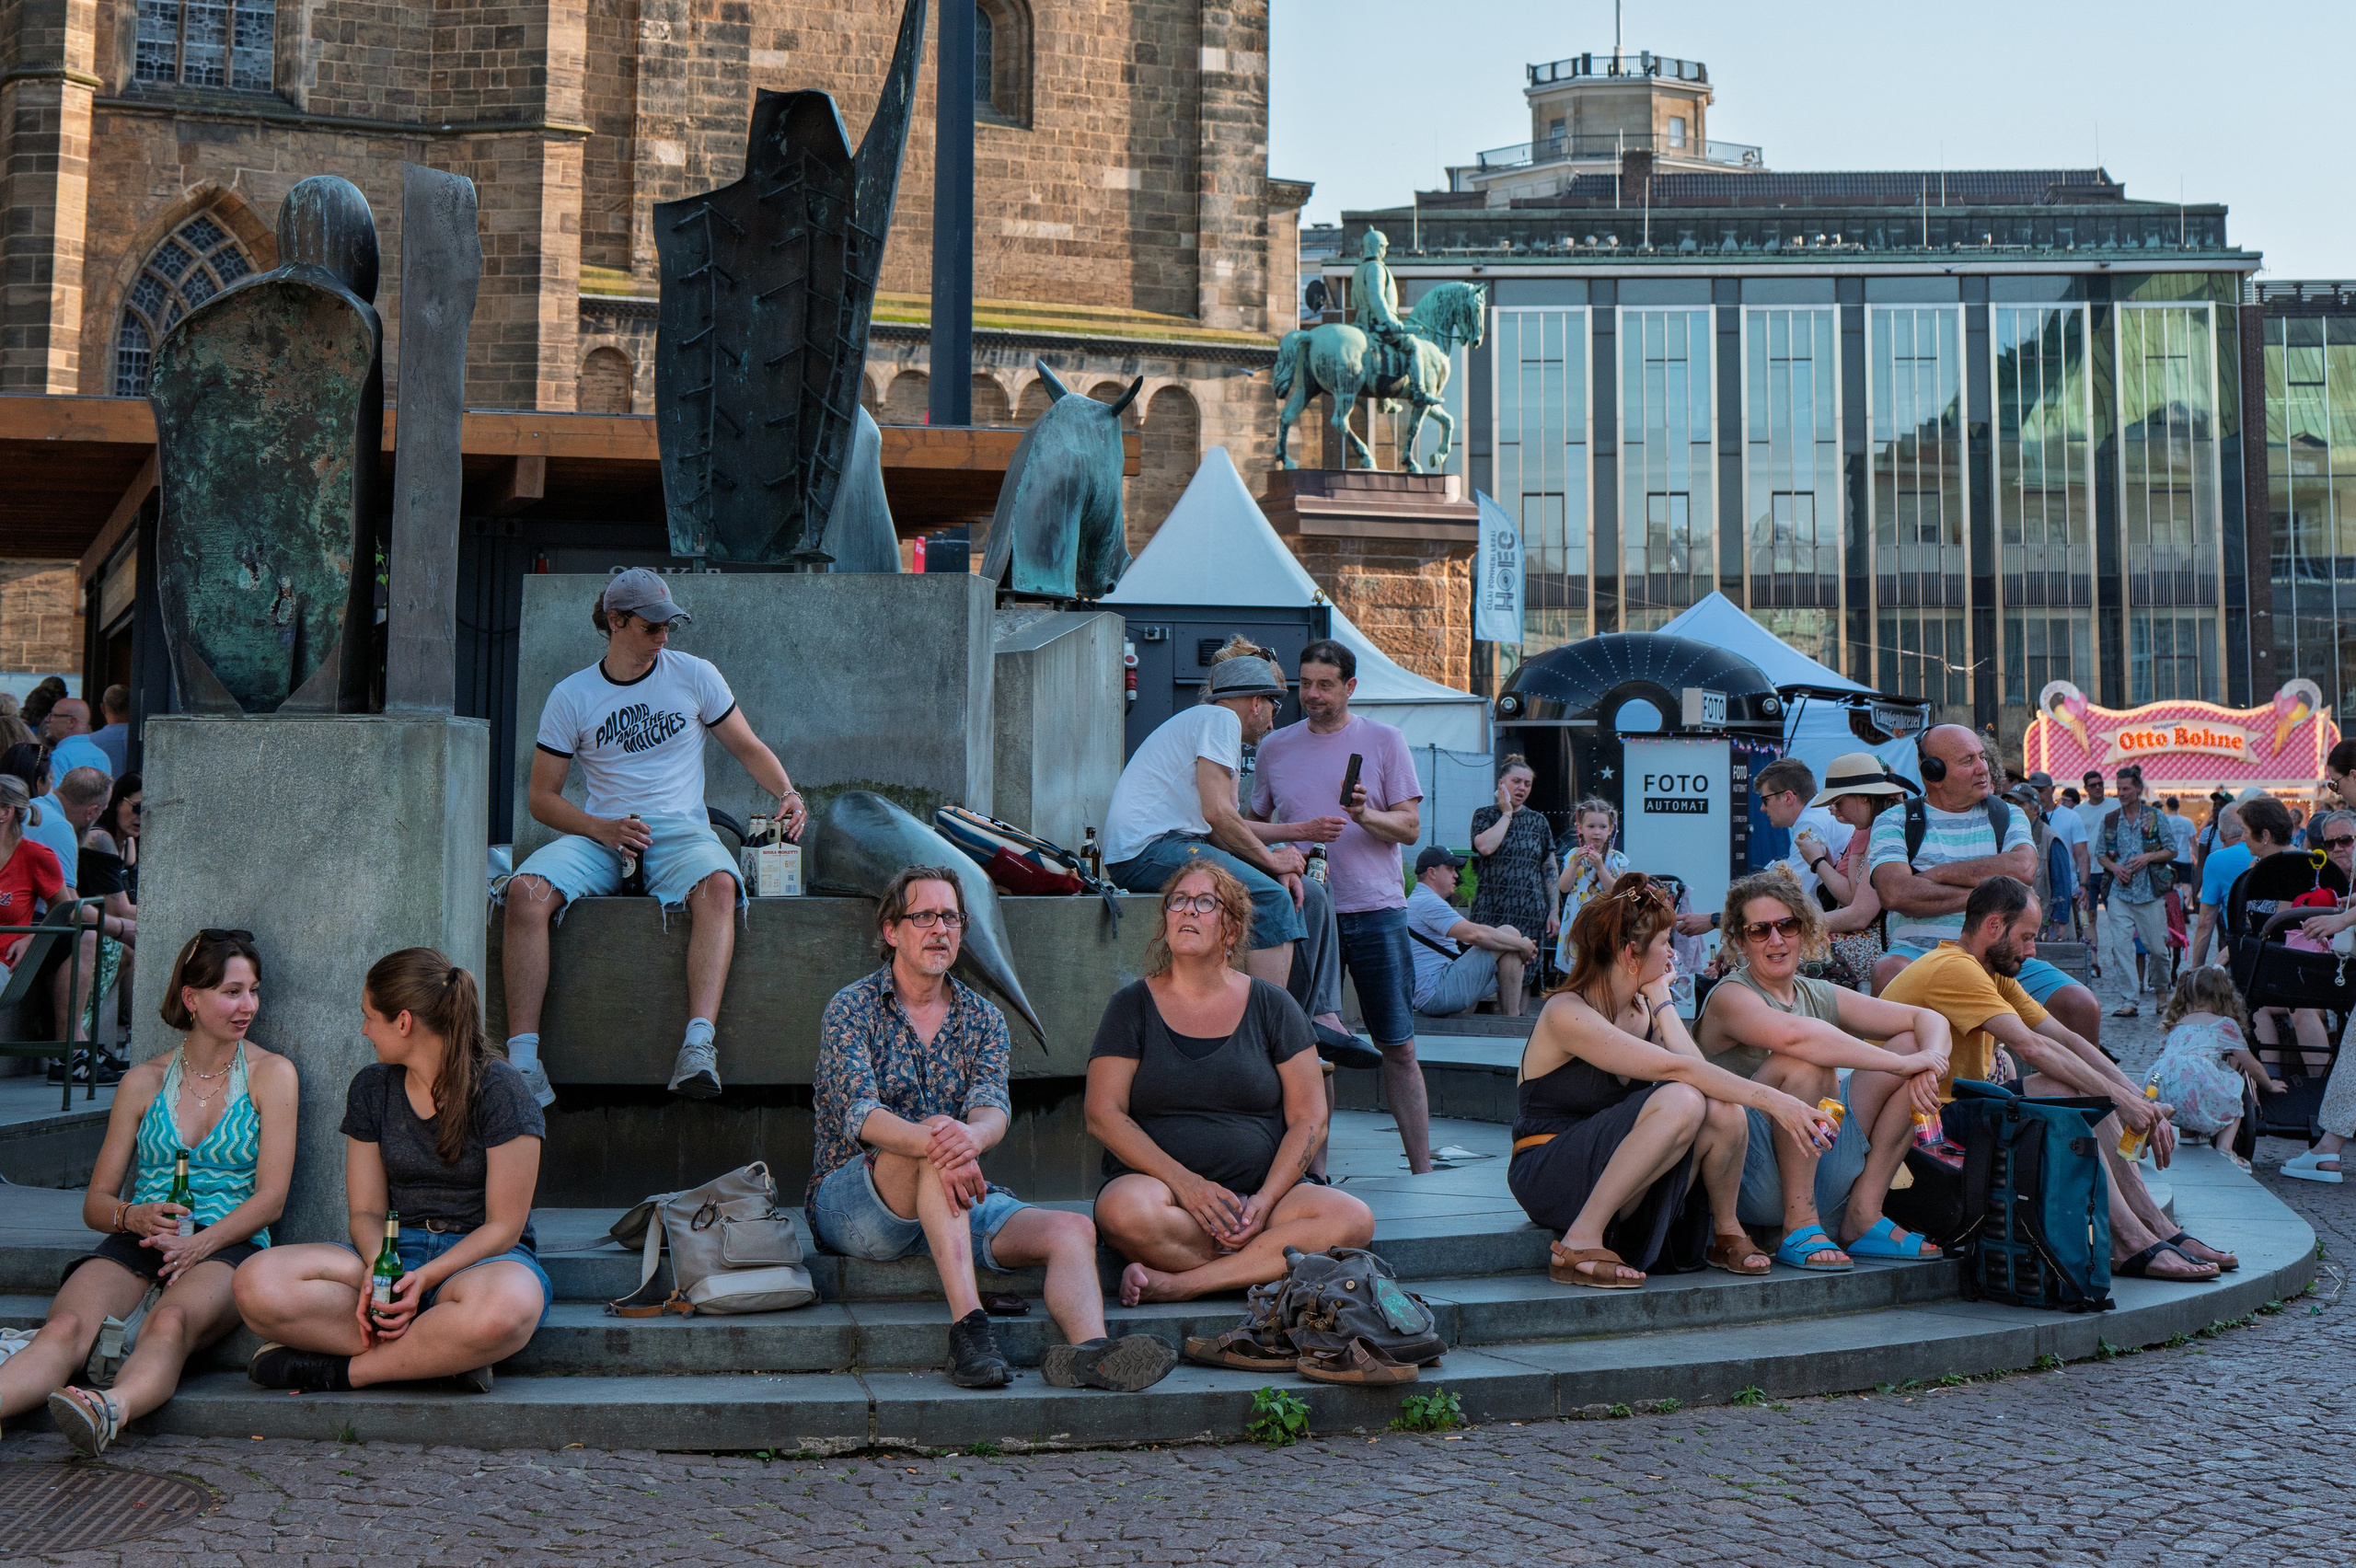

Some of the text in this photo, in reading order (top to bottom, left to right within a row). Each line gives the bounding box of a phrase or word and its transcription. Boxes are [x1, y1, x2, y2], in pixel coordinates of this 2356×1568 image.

[1703, 696, 1725, 721] FOTO
[595, 703, 650, 749] PALOMA
[616, 710, 664, 745] AND THE
[623, 711, 687, 753] MATCHES
[2152, 721, 2180, 731] Original
[2119, 727, 2244, 751] Otto Bohne
[1644, 774, 1709, 792] FOTO
[1732, 765, 1748, 780] FOTO
[1646, 801, 1705, 811] AUTOMAT
